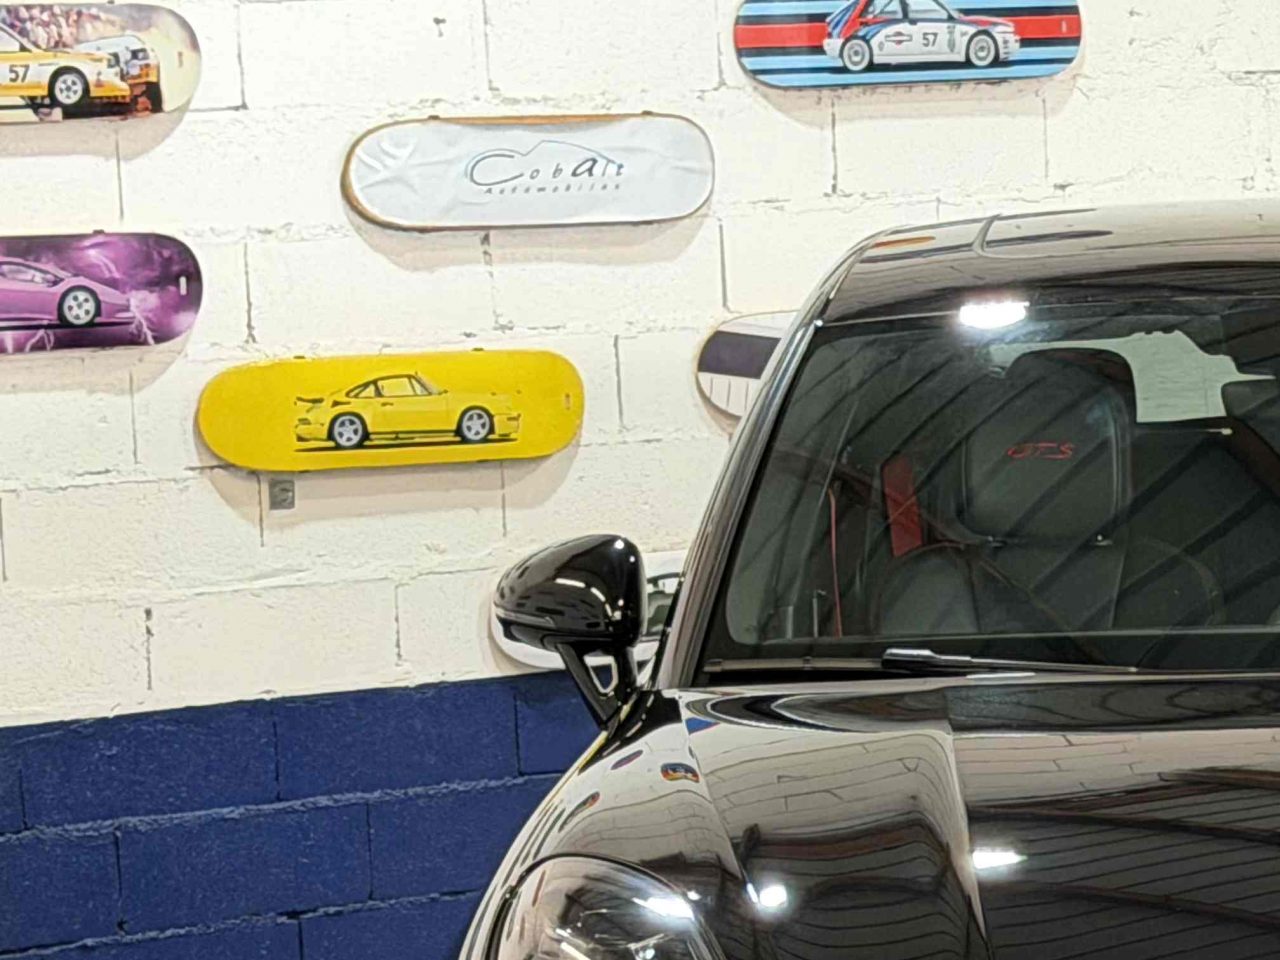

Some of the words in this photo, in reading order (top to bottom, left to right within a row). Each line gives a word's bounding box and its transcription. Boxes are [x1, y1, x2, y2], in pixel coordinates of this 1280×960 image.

[922, 32, 938, 48] 57
[8, 64, 30, 83] 57
[469, 153, 624, 187] Cobalt
